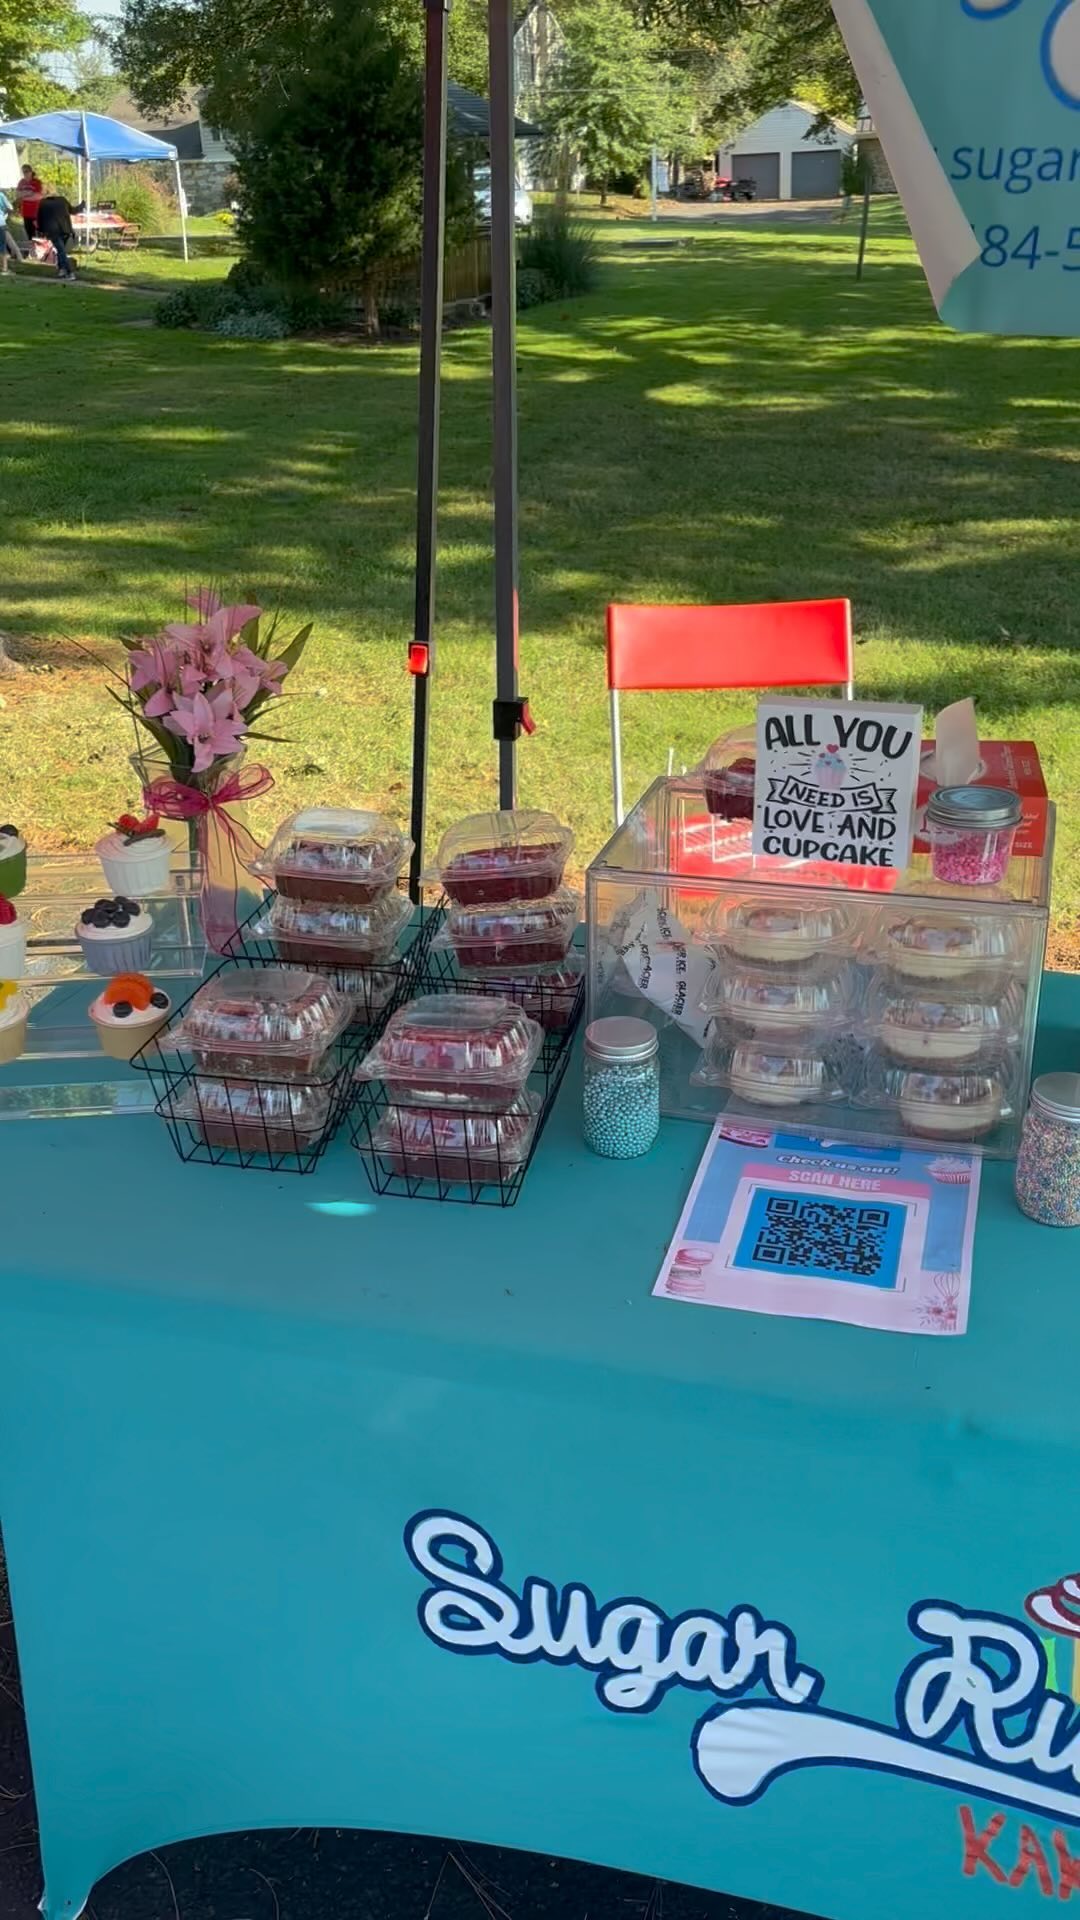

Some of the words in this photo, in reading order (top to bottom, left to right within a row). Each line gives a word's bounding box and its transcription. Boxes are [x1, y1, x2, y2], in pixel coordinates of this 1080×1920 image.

[970, 223, 1080, 271] 84-5
[765, 714, 821, 750] ALL
[833, 714, 913, 760] YOU
[787, 783, 845, 809] NEED
[852, 786, 873, 807] IS
[763, 806, 824, 833] LOVE
[837, 814, 897, 841] AND
[762, 835, 894, 867] CUPCAKE
[673, 980, 687, 1016] GLACIER
[776, 1154, 834, 1169] Check
[835, 1161, 858, 1172] us
[788, 1169, 834, 1185] SCAN
[838, 1175, 881, 1191] HERE
[403, 1508, 826, 1713] Sugar
